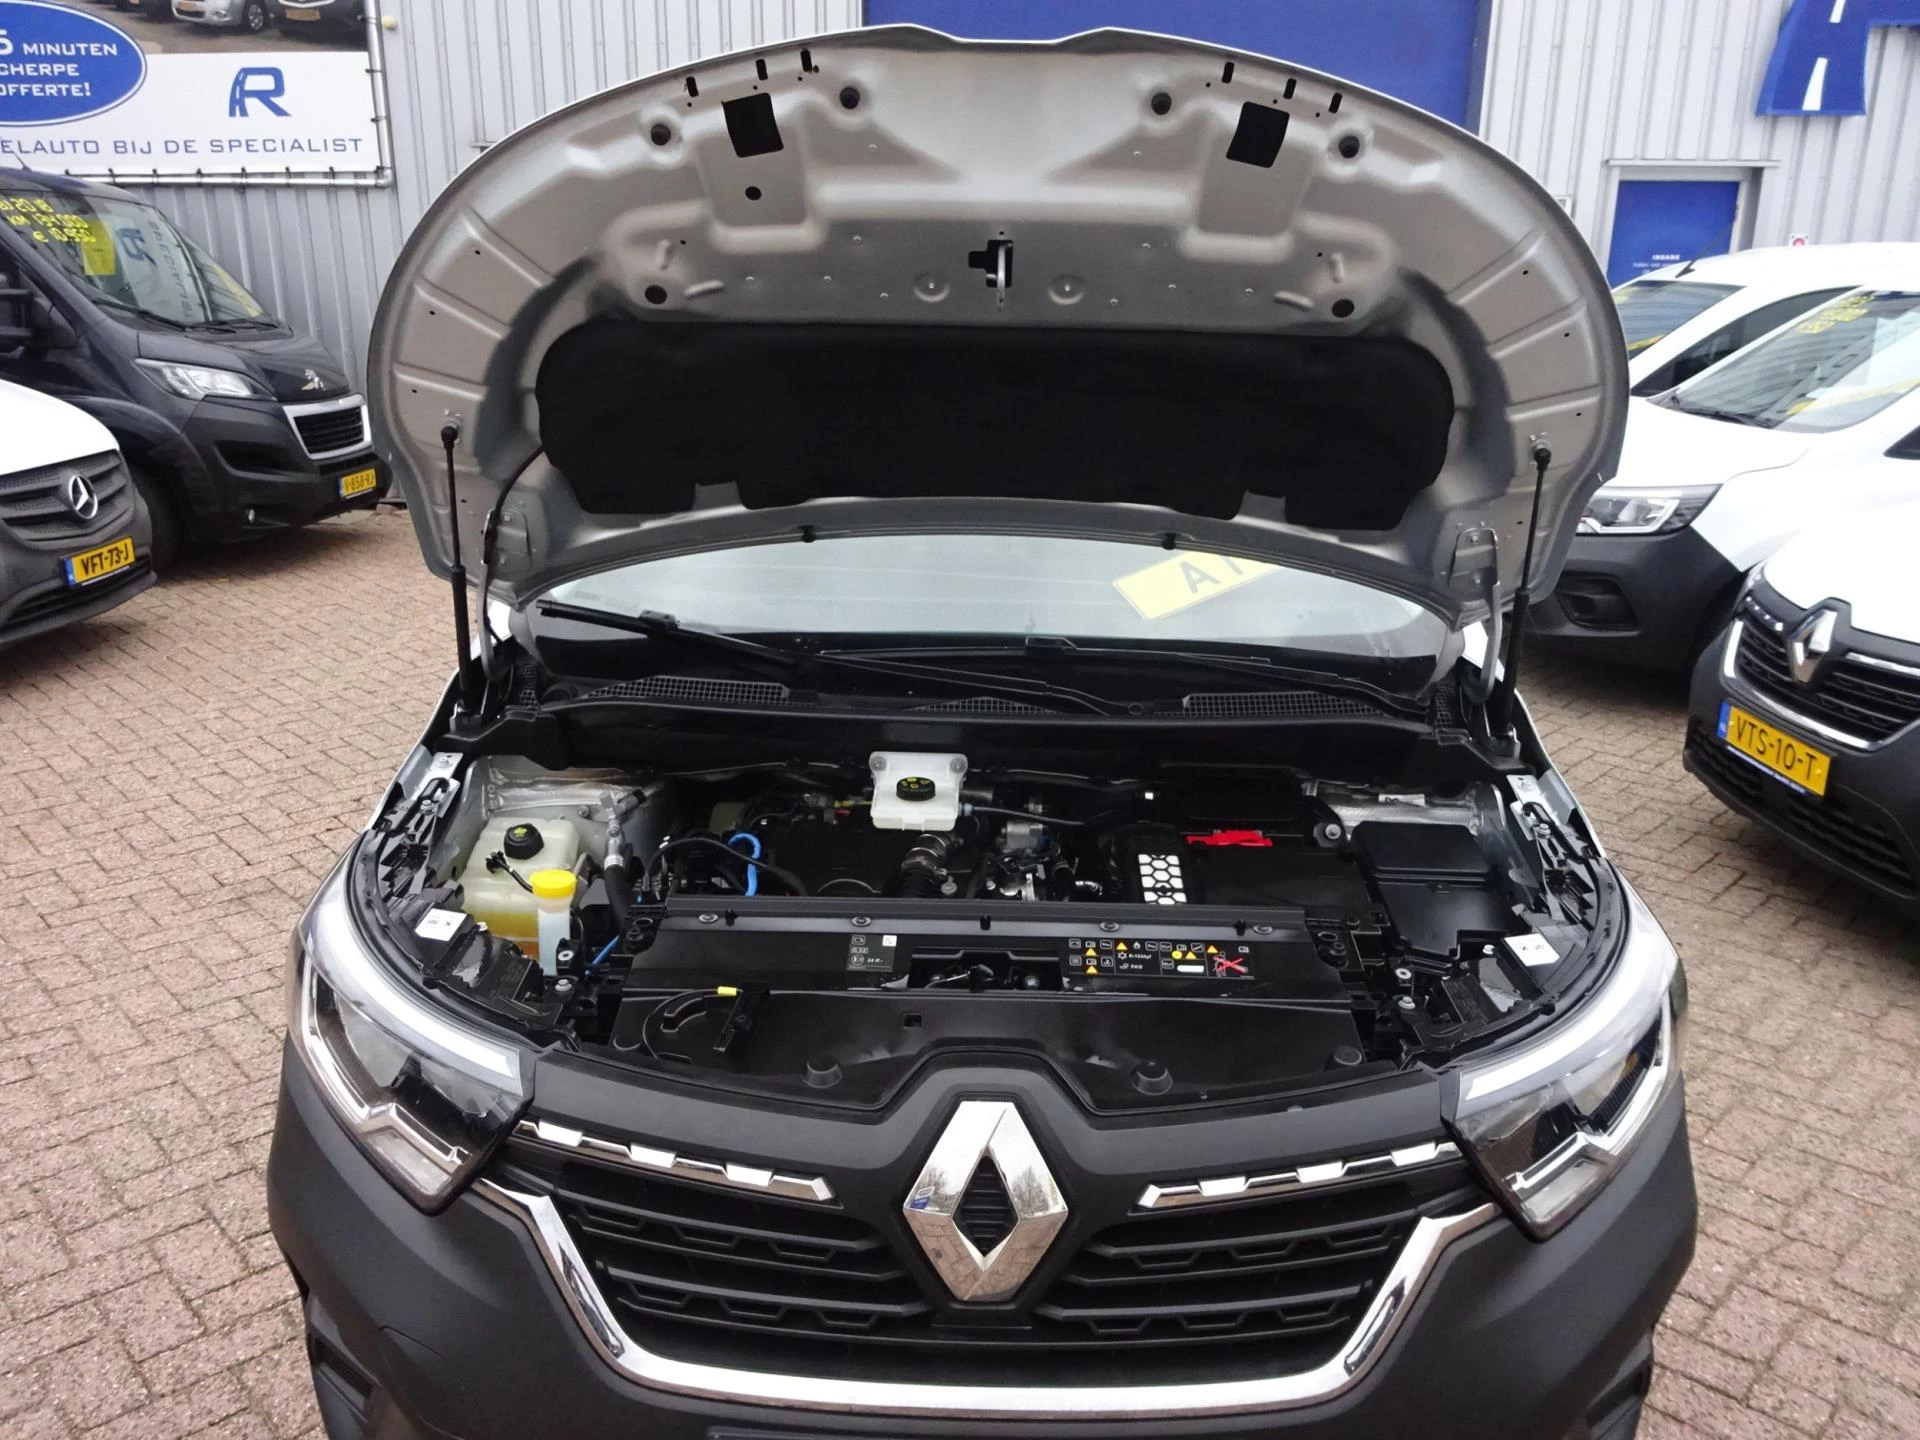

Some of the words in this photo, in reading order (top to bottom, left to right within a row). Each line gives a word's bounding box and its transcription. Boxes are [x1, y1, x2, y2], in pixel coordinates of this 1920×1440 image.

[23, 43, 118, 56] MINUTEN
[0, 63, 79, 76] CHERPE
[1, 139, 99, 154] ELAUTO
[114, 139, 153, 154] BIJ
[165, 139, 198, 154] DE
[210, 138, 363, 154] SPECIALIST
[81, 543, 130, 576] VFT-73-J
[1736, 715, 1818, 781] VTS-10-T
